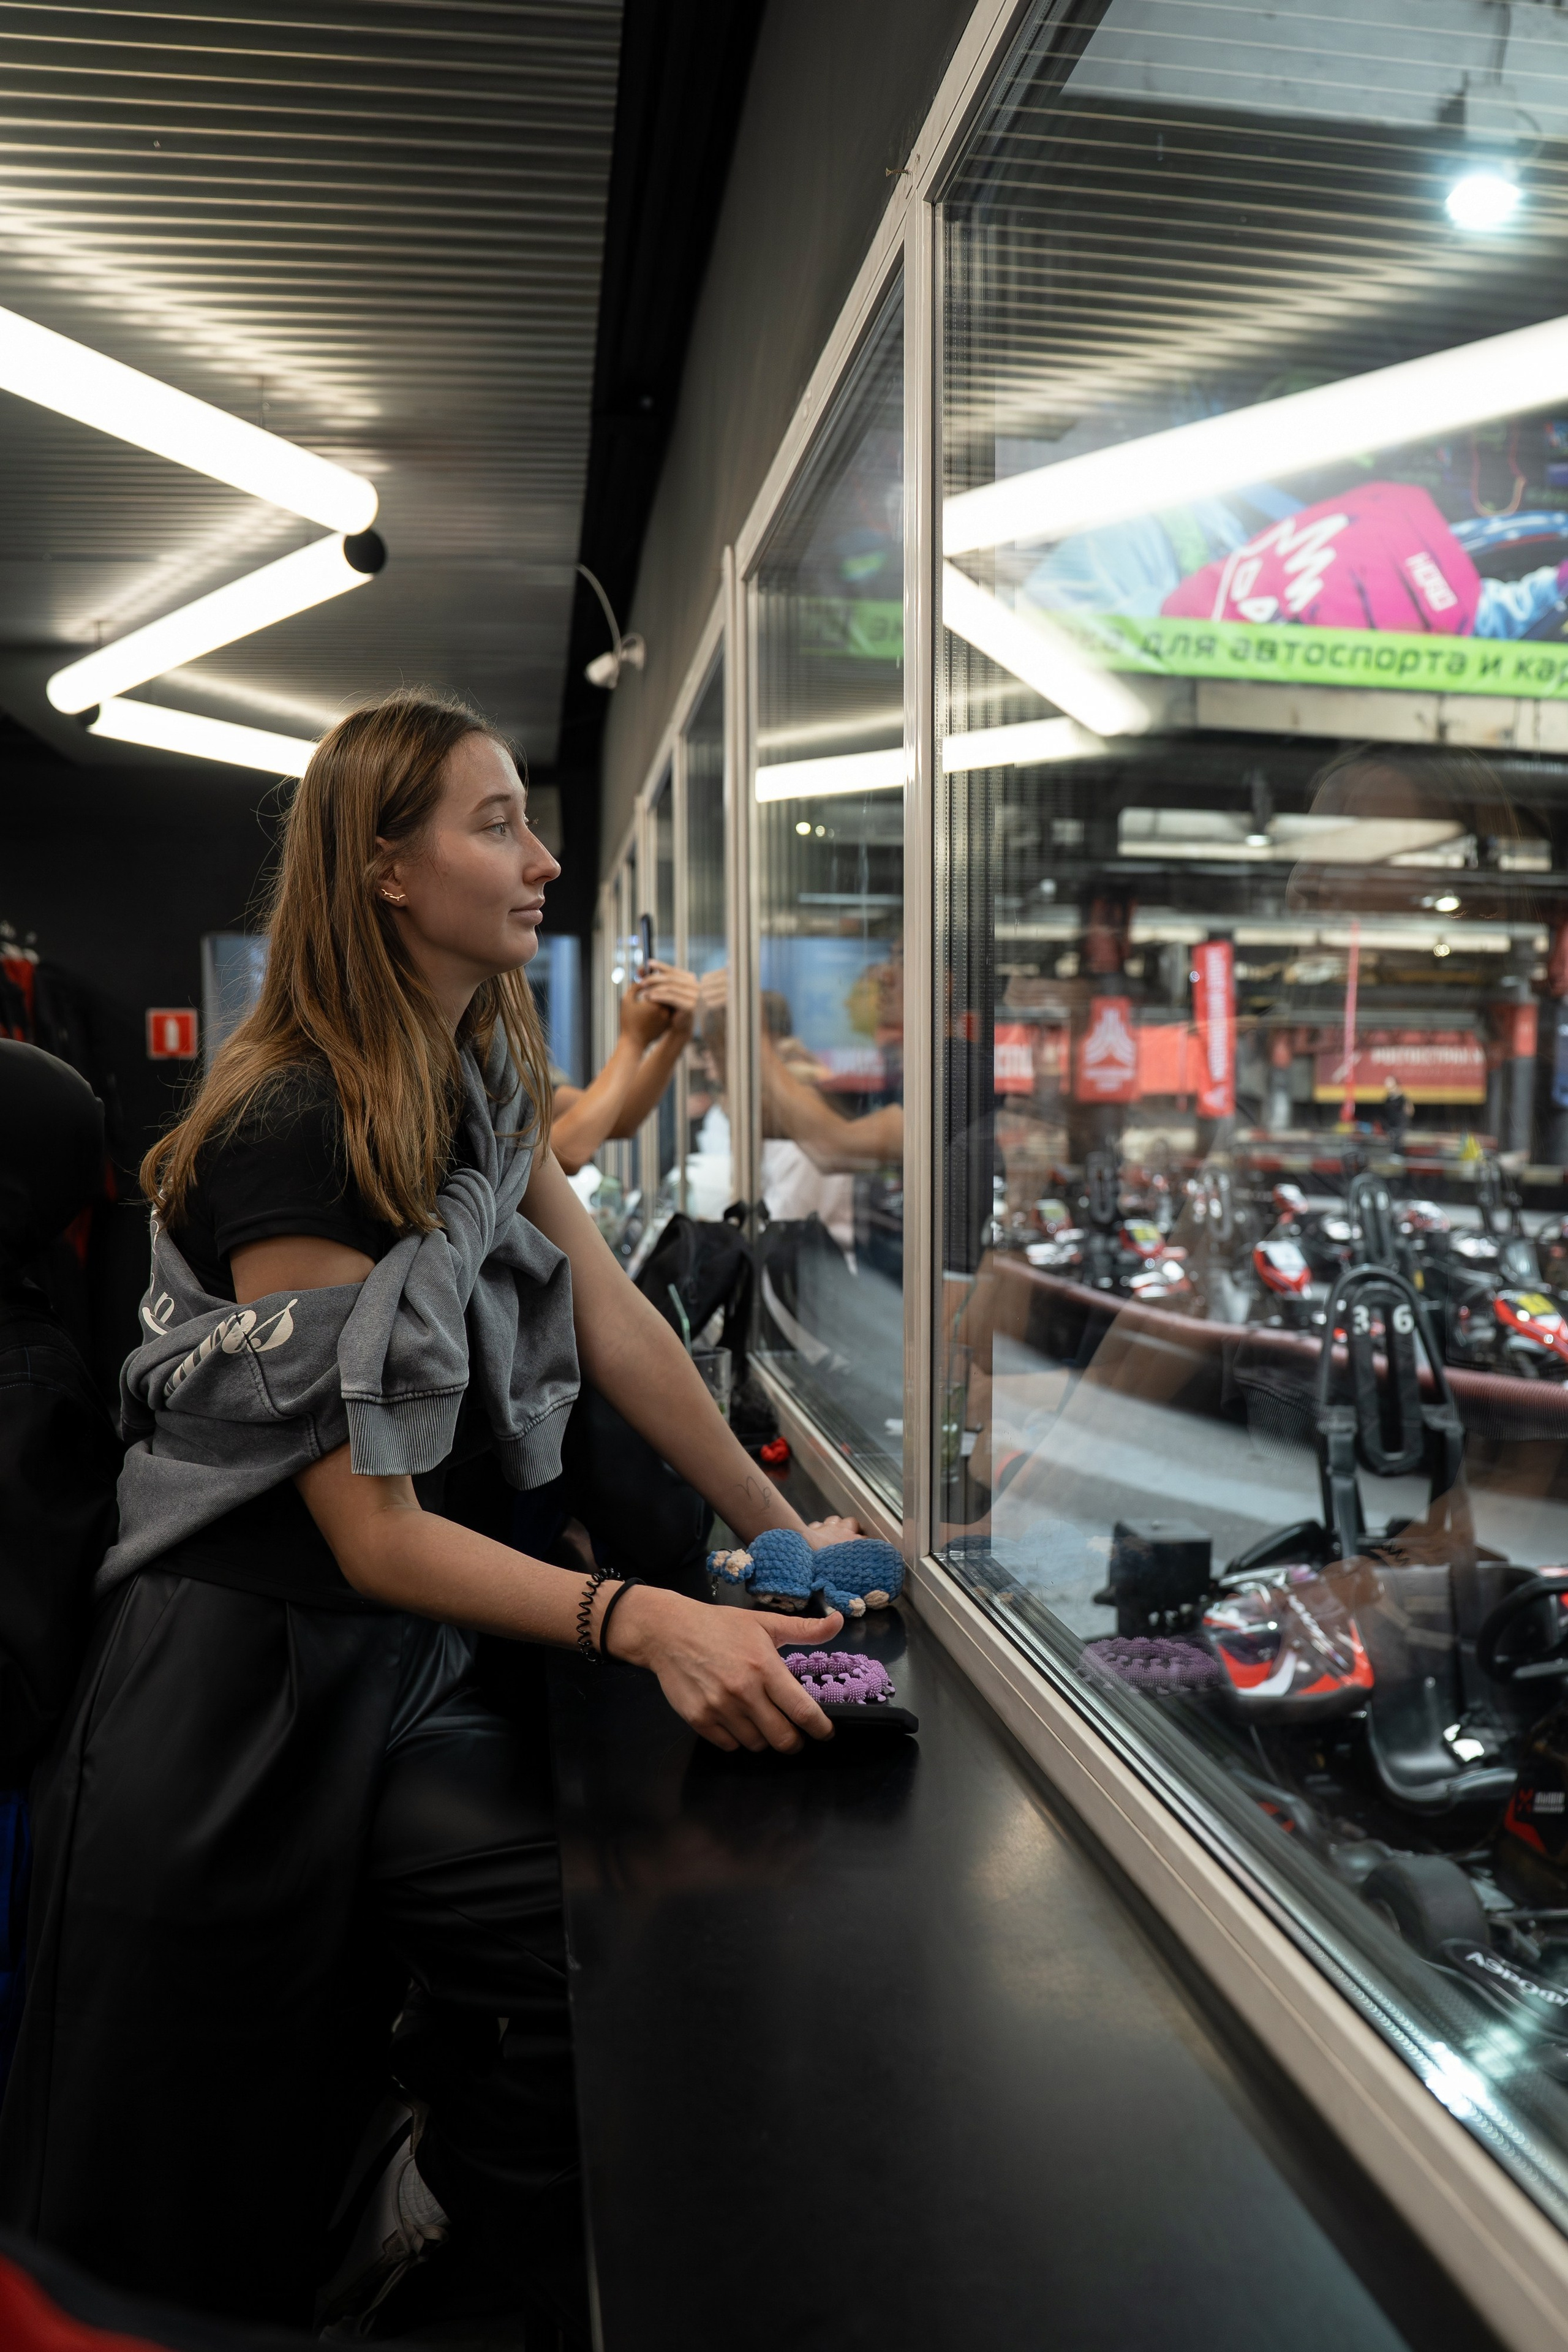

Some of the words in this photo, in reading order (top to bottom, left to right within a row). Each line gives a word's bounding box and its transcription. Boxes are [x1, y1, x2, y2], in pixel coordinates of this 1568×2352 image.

[1228, 636, 1468, 676] автоспорта
[1478, 651, 1502, 678] и
[1464, 1951, 1568, 2007] АЭРОФ
